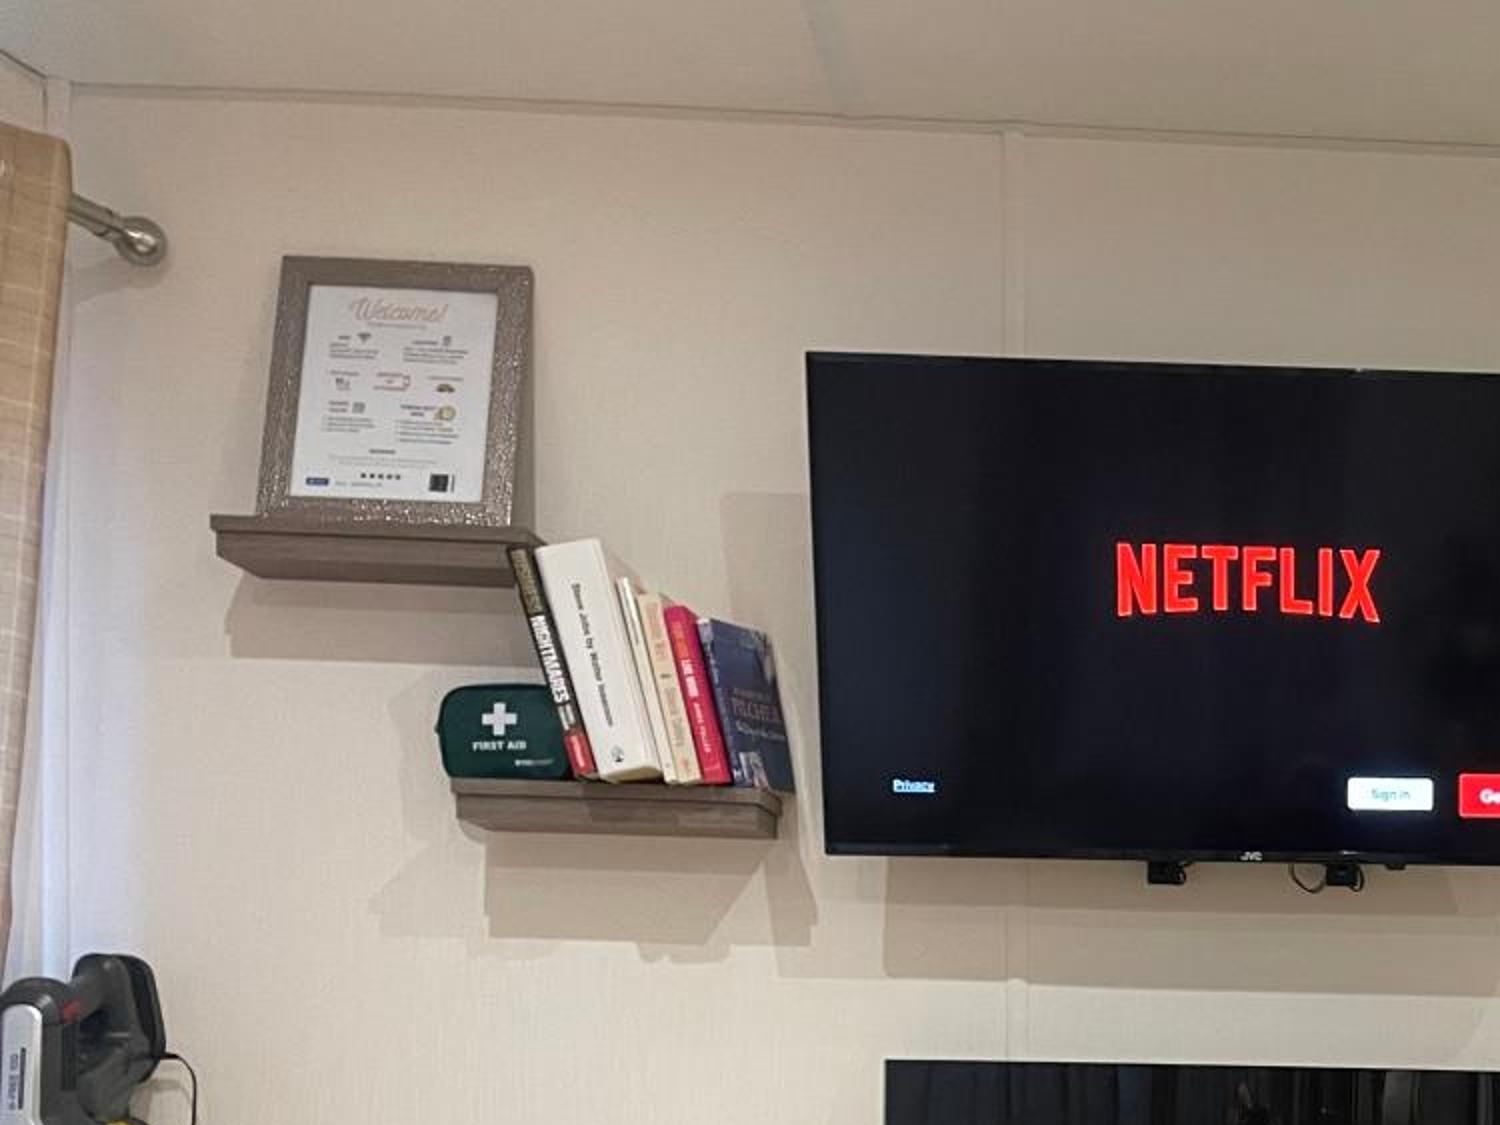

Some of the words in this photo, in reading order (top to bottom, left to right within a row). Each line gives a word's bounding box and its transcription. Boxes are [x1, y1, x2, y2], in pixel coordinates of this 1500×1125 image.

[1116, 542, 1381, 624] NETFLIX
[472, 741, 504, 752] FIRST
[507, 740, 527, 751] AID
[1240, 851, 1263, 861] JVC
